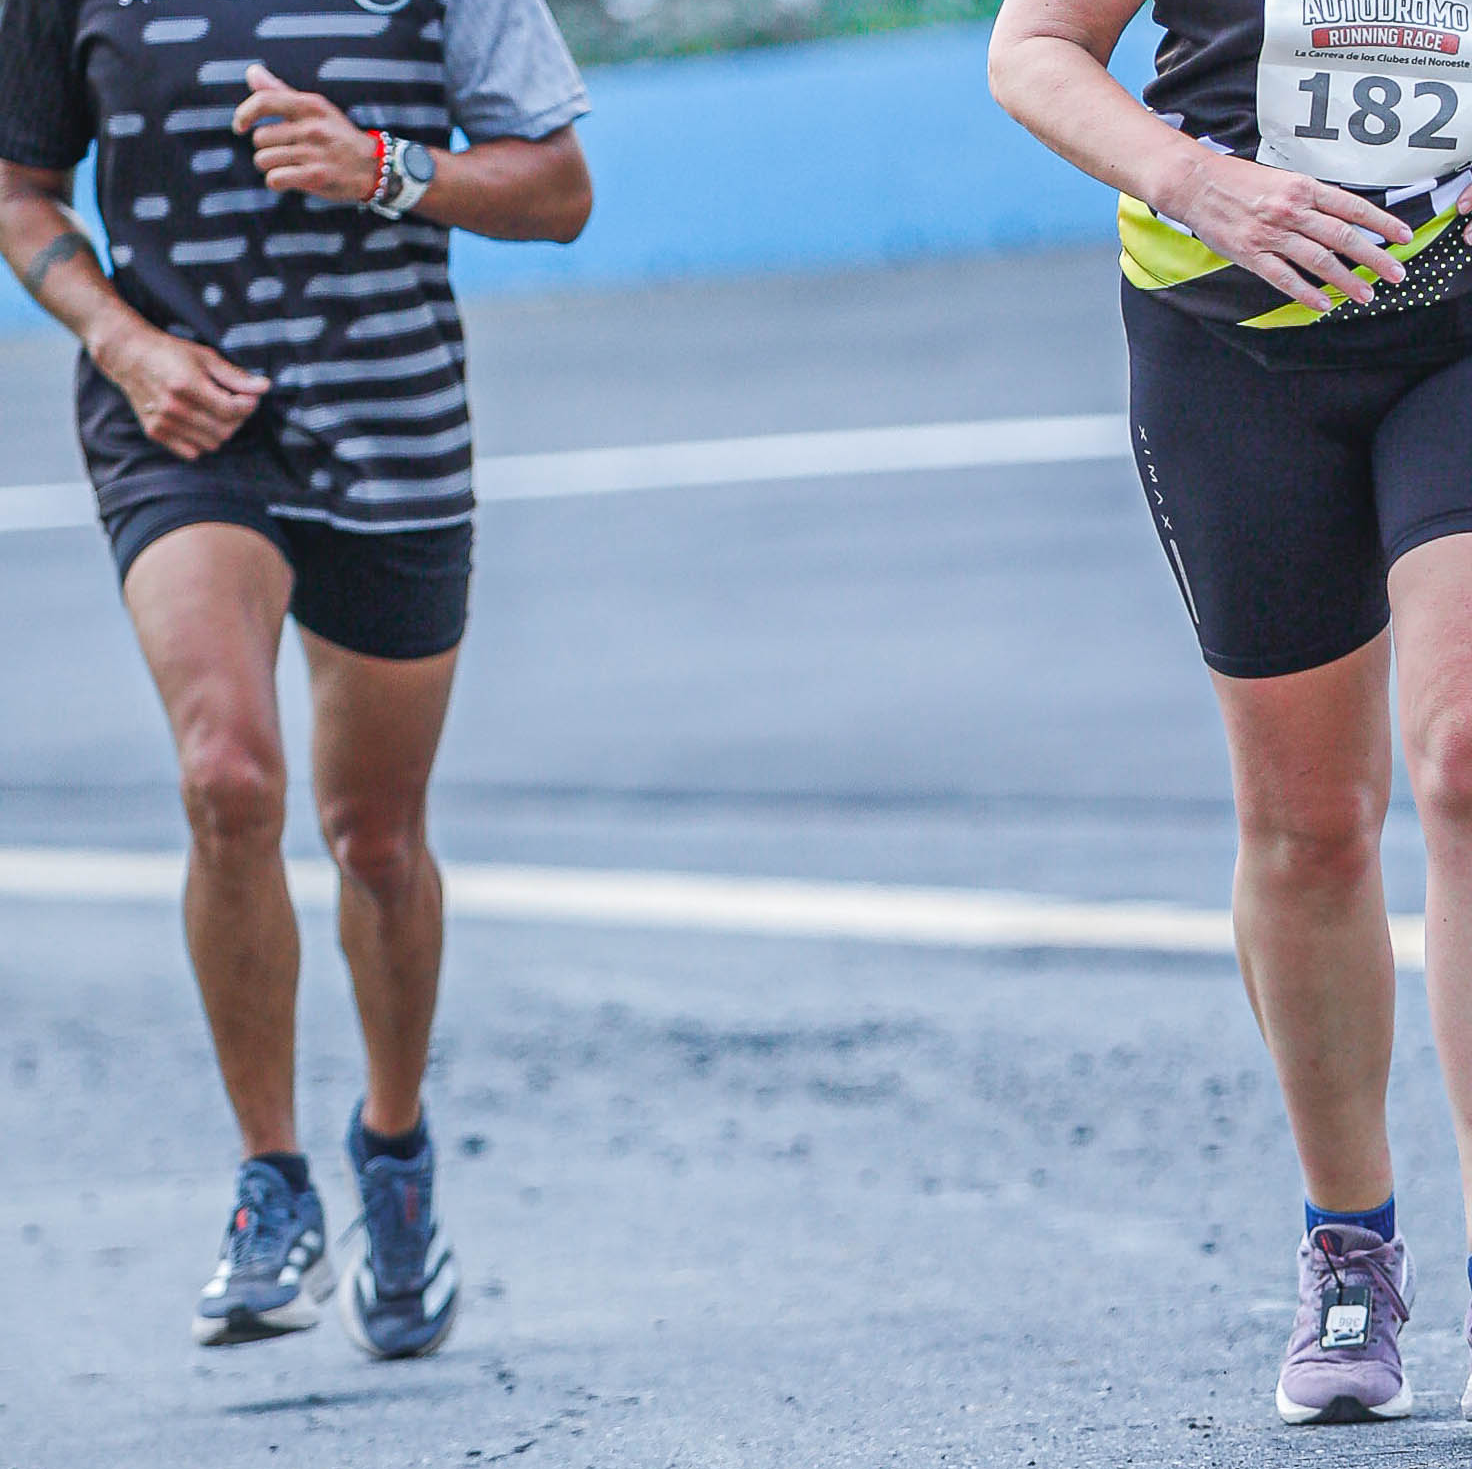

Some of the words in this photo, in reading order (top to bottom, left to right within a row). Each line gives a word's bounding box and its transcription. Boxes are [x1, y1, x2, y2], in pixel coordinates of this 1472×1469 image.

[1327, 27, 1399, 47] RUNNING
[1402, 28, 1444, 51] RACE
[1294, 49, 1306, 57] La
[1308, 50, 1345, 59] Carrera
[1346, 52, 1360, 61] de
[1361, 52, 1376, 62] los
[1377, 53, 1410, 64] Clubes
[1411, 56, 1427, 65] del
[1428, 57, 1471, 69] Noroeste
[1294, 72, 1459, 150] 182
